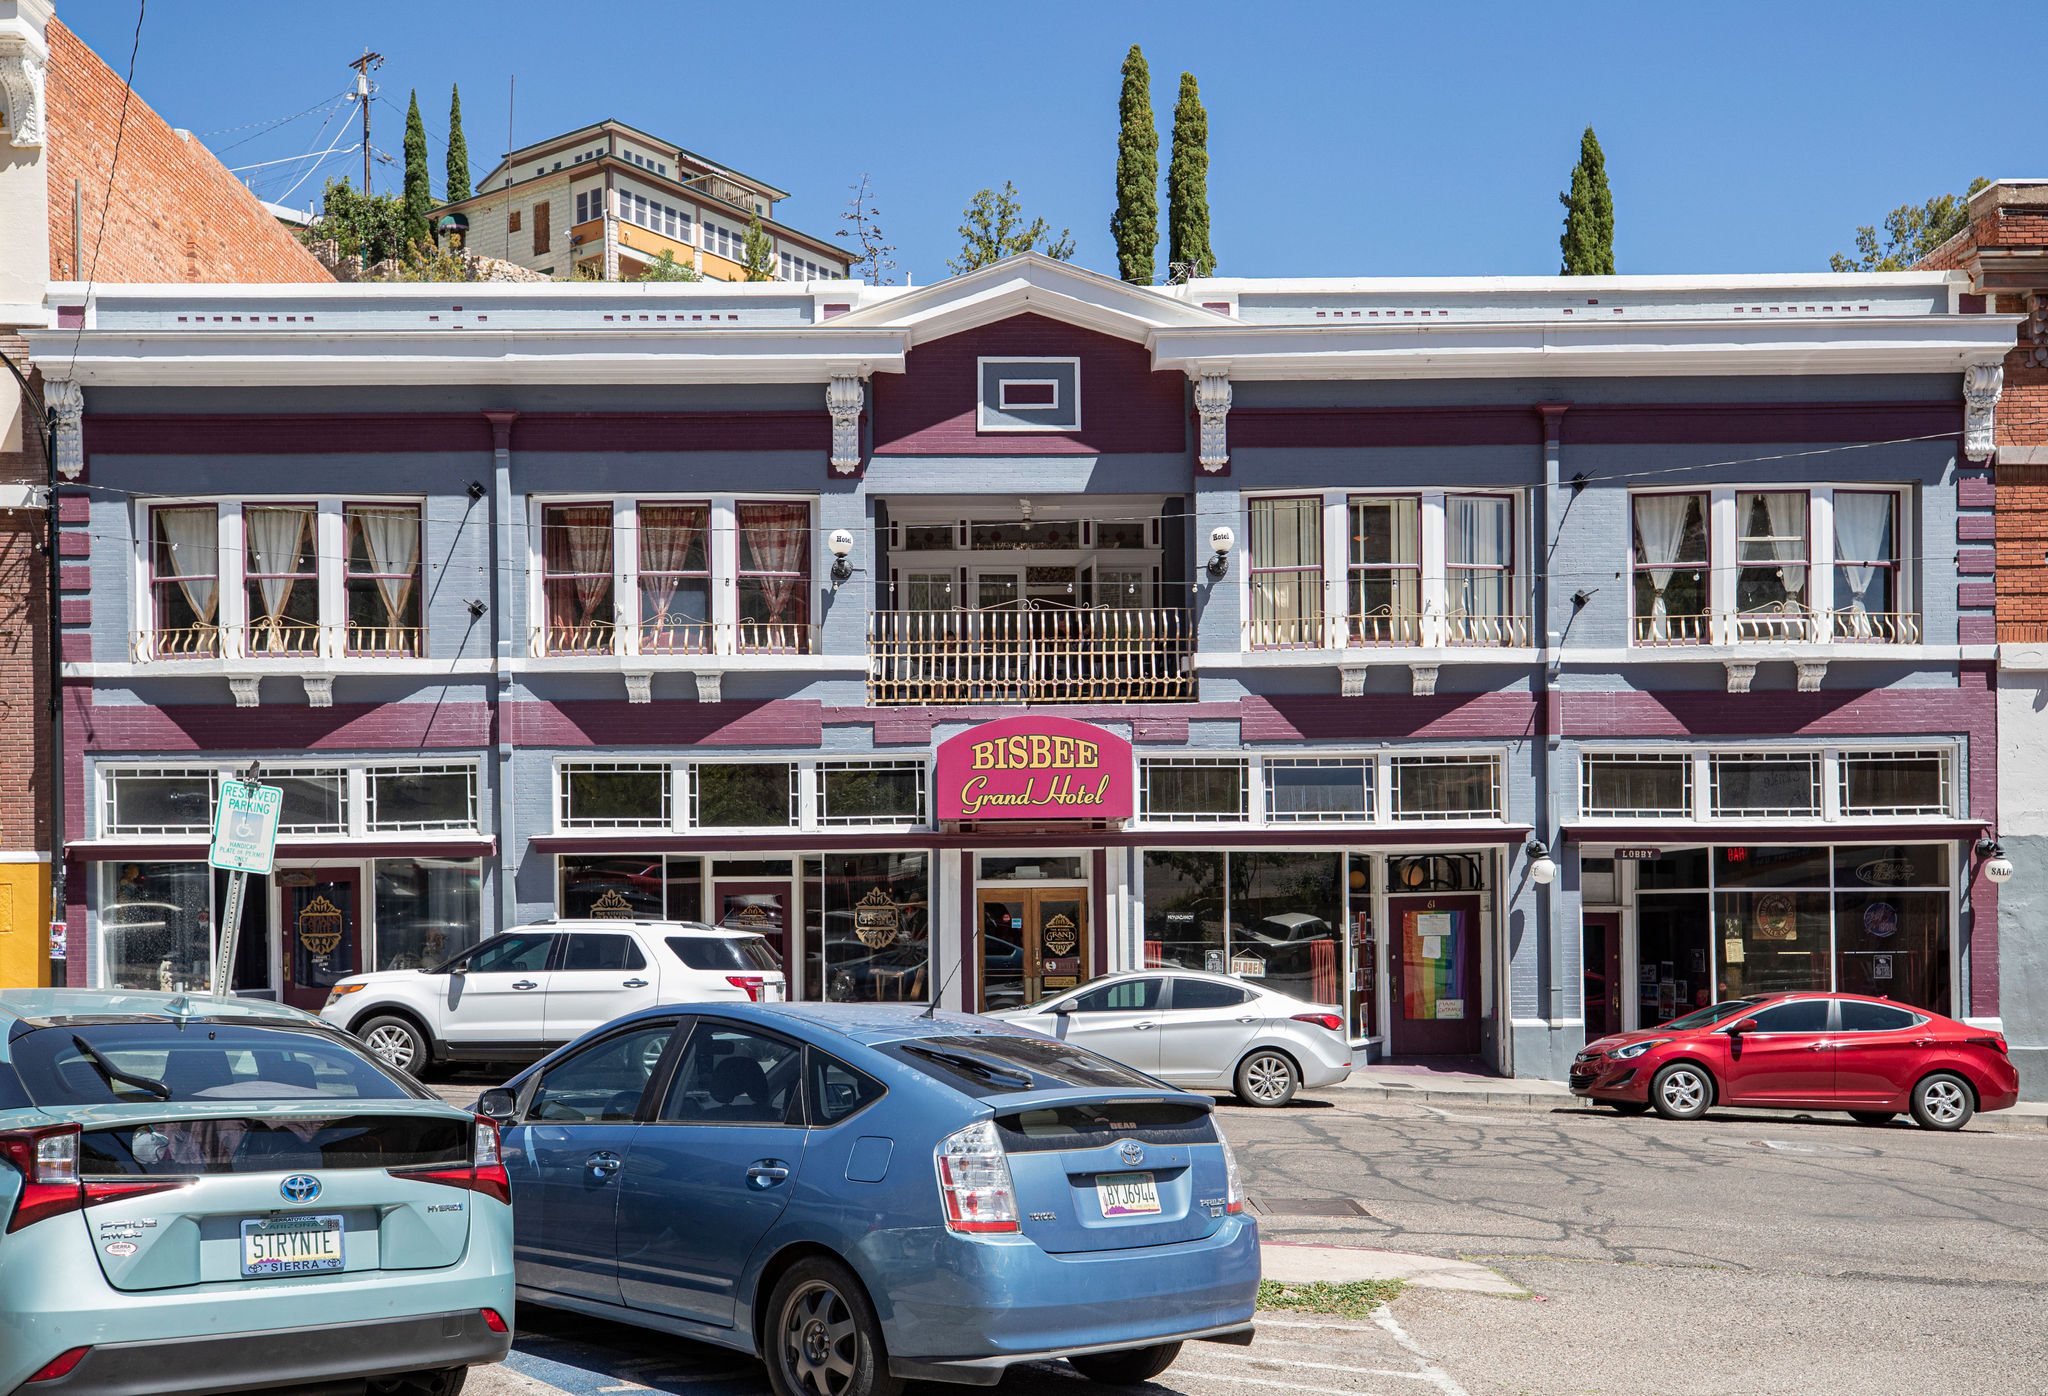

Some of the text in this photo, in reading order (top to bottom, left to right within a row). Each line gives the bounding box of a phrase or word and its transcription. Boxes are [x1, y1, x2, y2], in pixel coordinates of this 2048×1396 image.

[836, 535, 852, 544] Hotel
[1212, 532, 1230, 541] Hotel
[971, 734, 1099, 770] BISBEE
[225, 785, 277, 804] RESERVED
[961, 774, 1110, 814] Grand Hotel
[228, 798, 271, 815] PARKING
[219, 846, 236, 855] PLATE
[229, 841, 257, 850] HANDICAP
[1622, 850, 1653, 858] LOBBY
[1727, 846, 1745, 861] BAR
[1427, 899, 1436, 909] 61
[1046, 931, 1075, 941] GRAND
[1763, 923, 1791, 937] PALE ALE
[1106, 1182, 1155, 1205] BYJ6944
[100, 1218, 157, 1230] PRIUS
[269, 1222, 318, 1230] ARIZONA
[253, 1230, 334, 1259] STRYNTE
[271, 1260, 319, 1272] SIERRA
